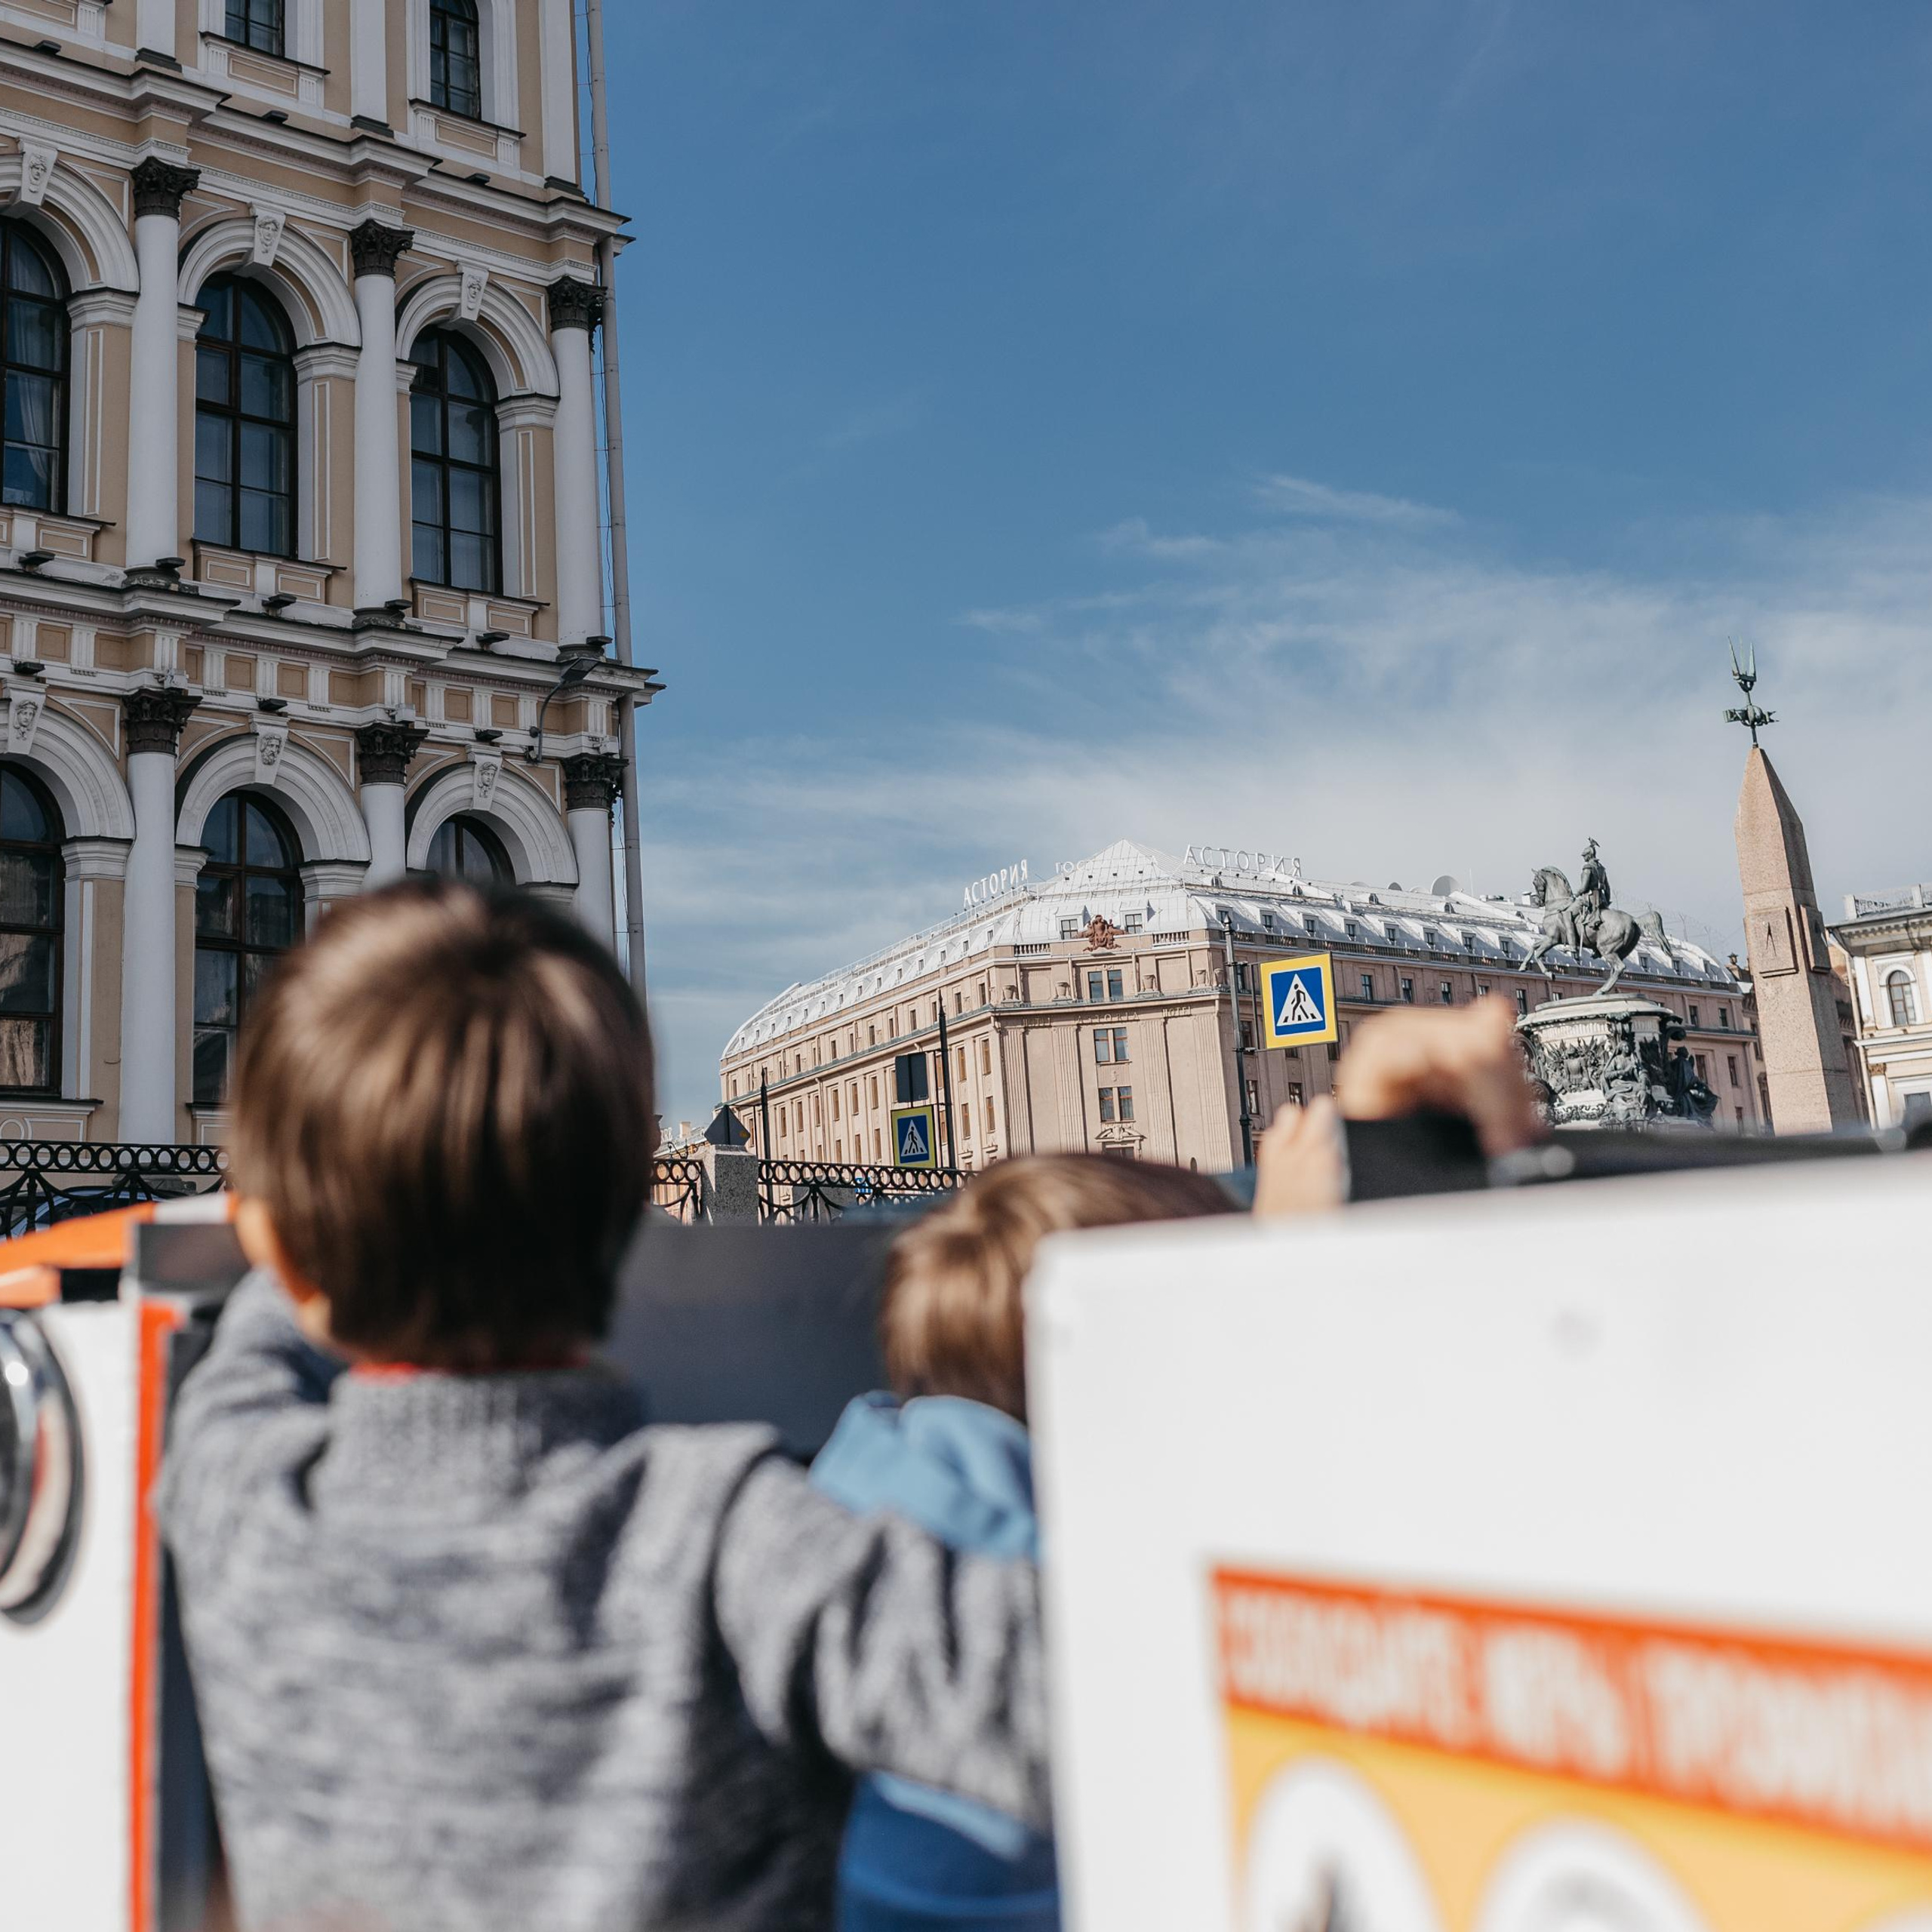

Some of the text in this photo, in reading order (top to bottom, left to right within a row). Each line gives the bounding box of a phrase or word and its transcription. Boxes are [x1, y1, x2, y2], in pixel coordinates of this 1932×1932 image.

[1183, 844, 1302, 878] АСТОРИЯ
[964, 859, 1028, 907] АСТОРИЯ
[1162, 1005, 1192, 1017] HOTEL
